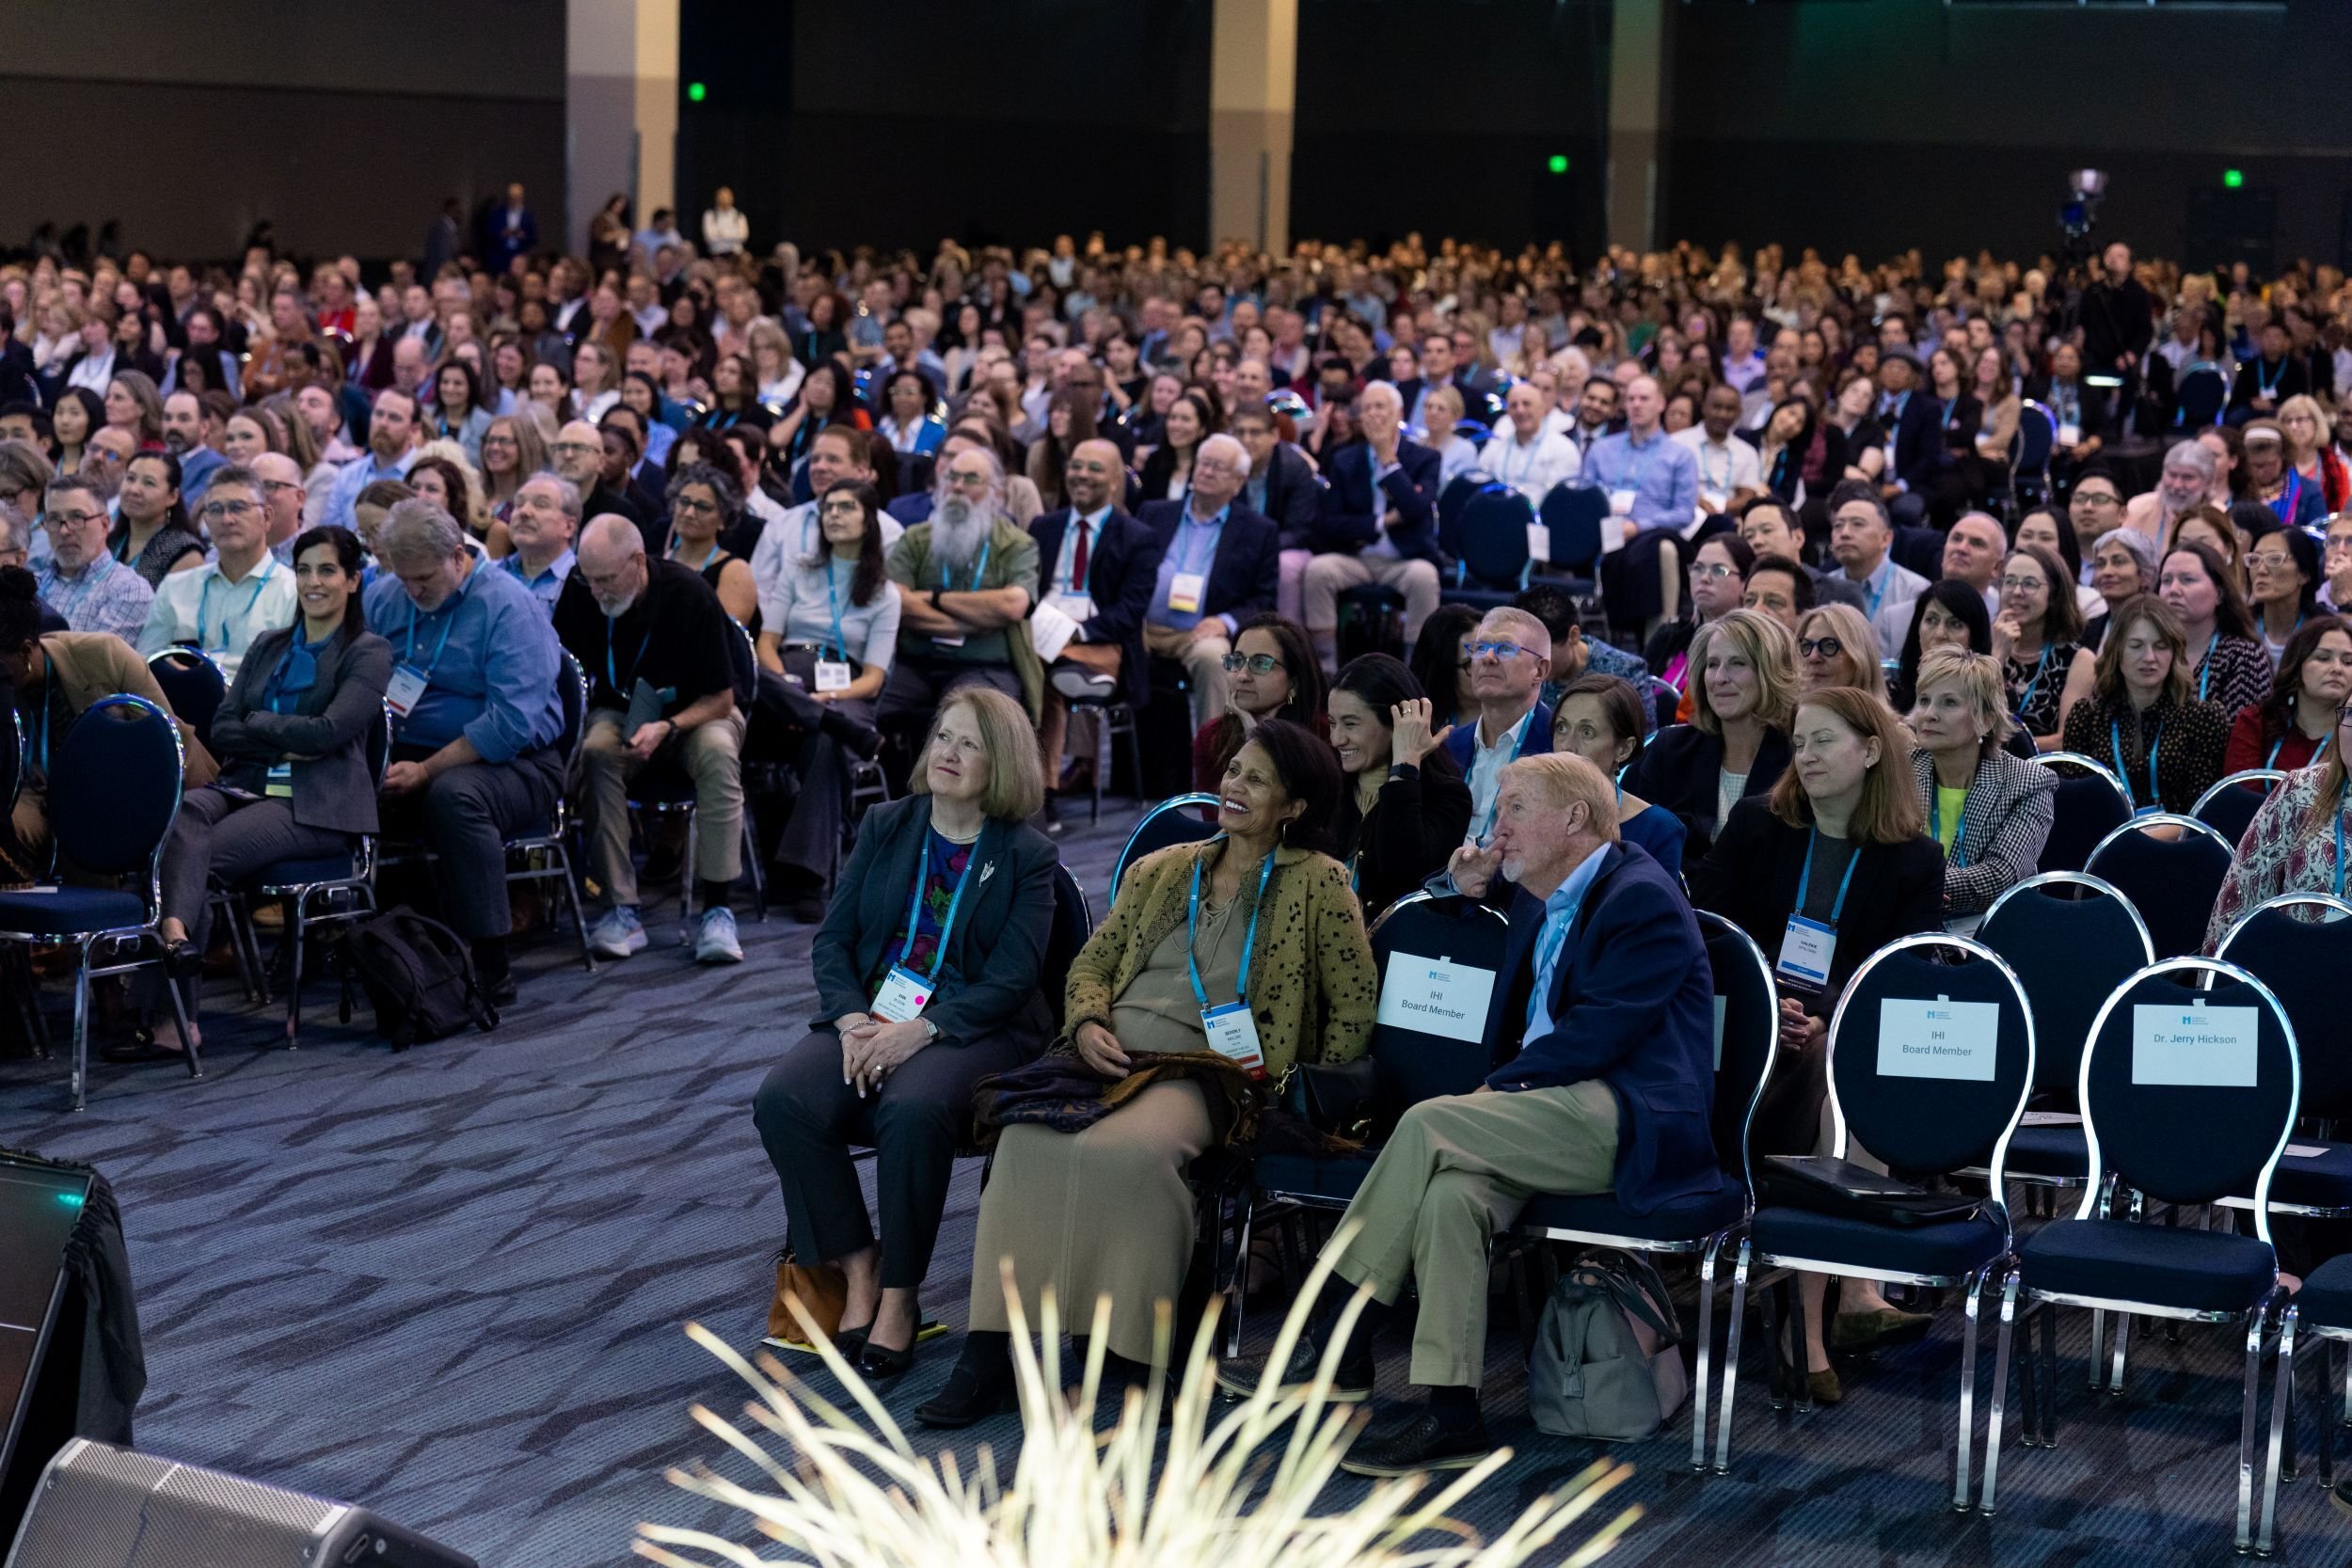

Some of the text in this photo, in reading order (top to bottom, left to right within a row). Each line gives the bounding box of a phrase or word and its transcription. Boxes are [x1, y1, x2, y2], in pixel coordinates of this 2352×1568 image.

[1430, 990, 1443, 1001] IHI
[1401, 999, 1466, 1020] Board Member
[1931, 1031, 1945, 1040] IHI
[2153, 1034, 2236, 1045] Dr. Jerry Hickson
[1902, 1044, 1972, 1056] Board Member
